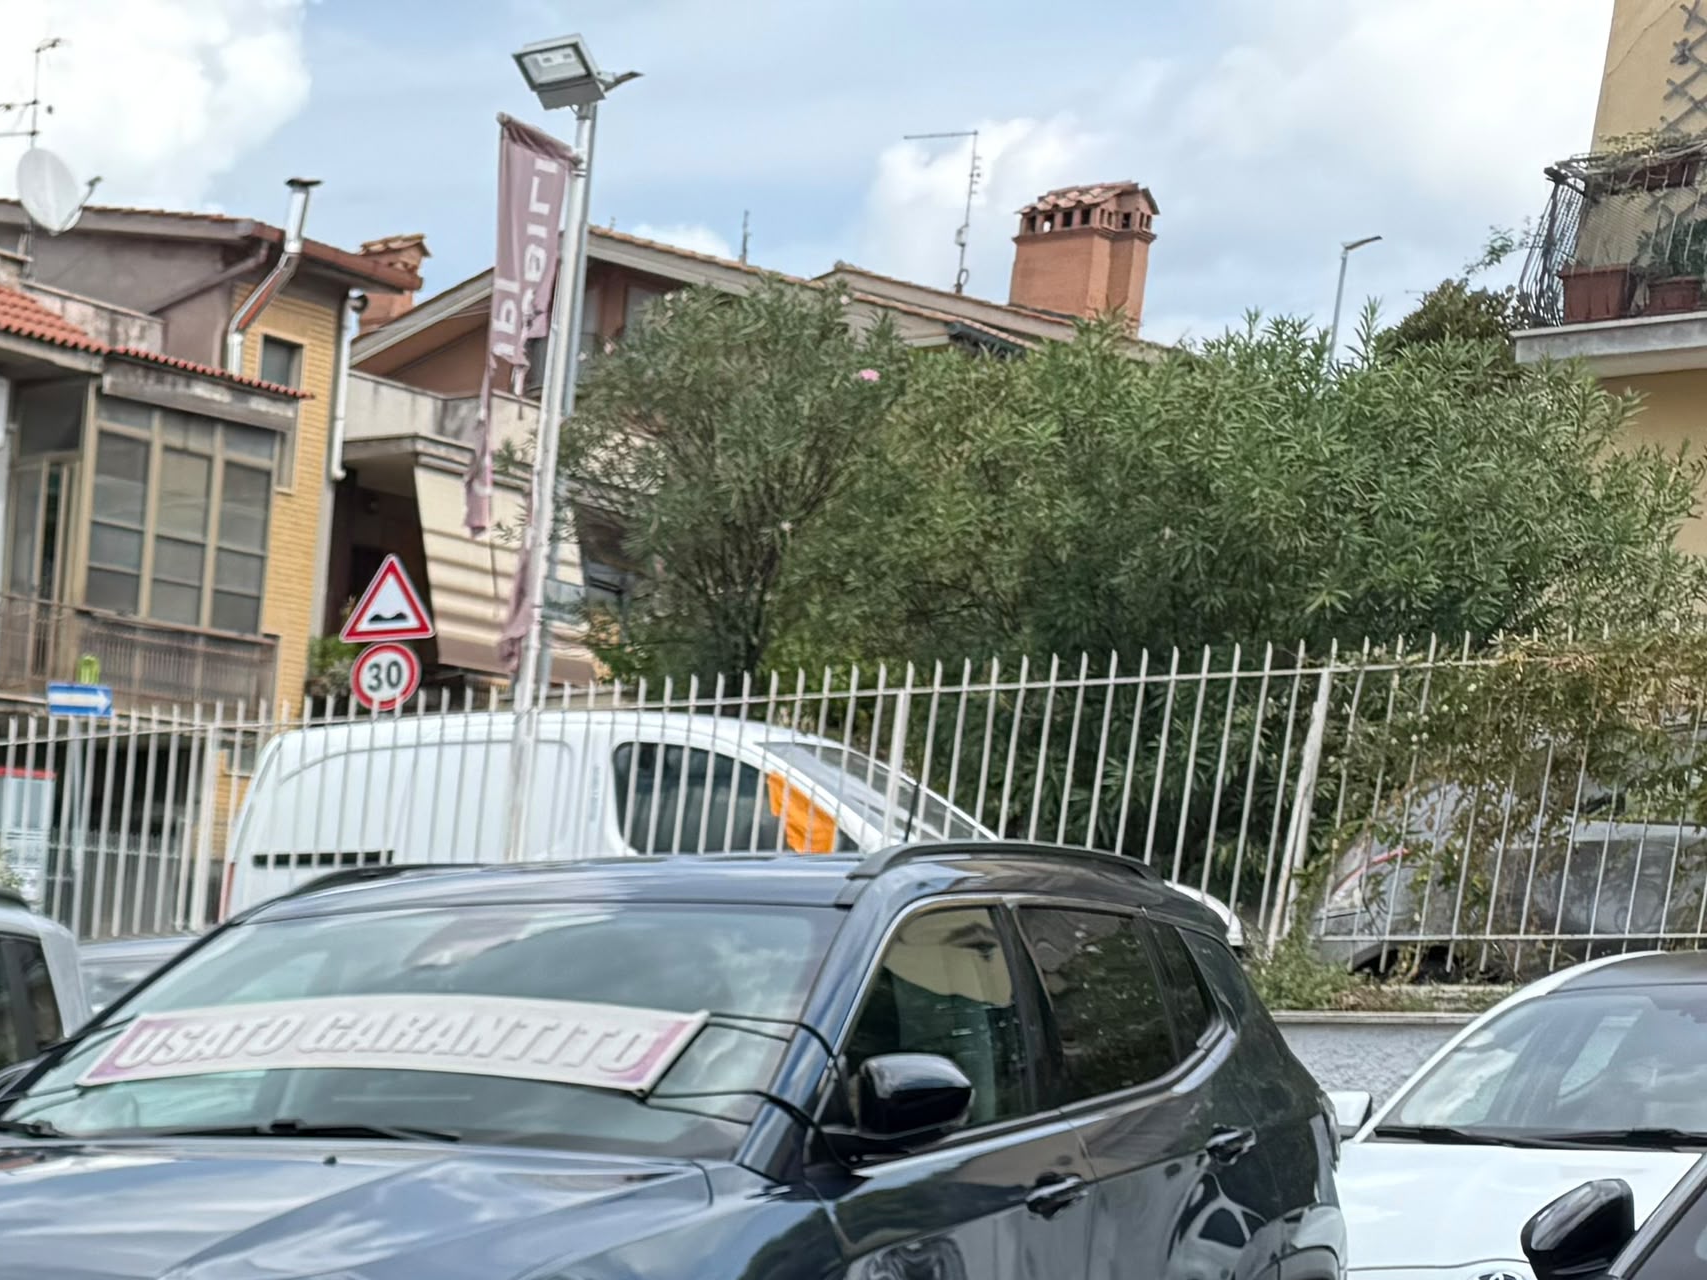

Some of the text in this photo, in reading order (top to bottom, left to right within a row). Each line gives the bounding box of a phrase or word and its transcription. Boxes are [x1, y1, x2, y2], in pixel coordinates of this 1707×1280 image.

[367, 660, 403, 692] 30
[113, 1009, 653, 1075] USATO GARANTITO
